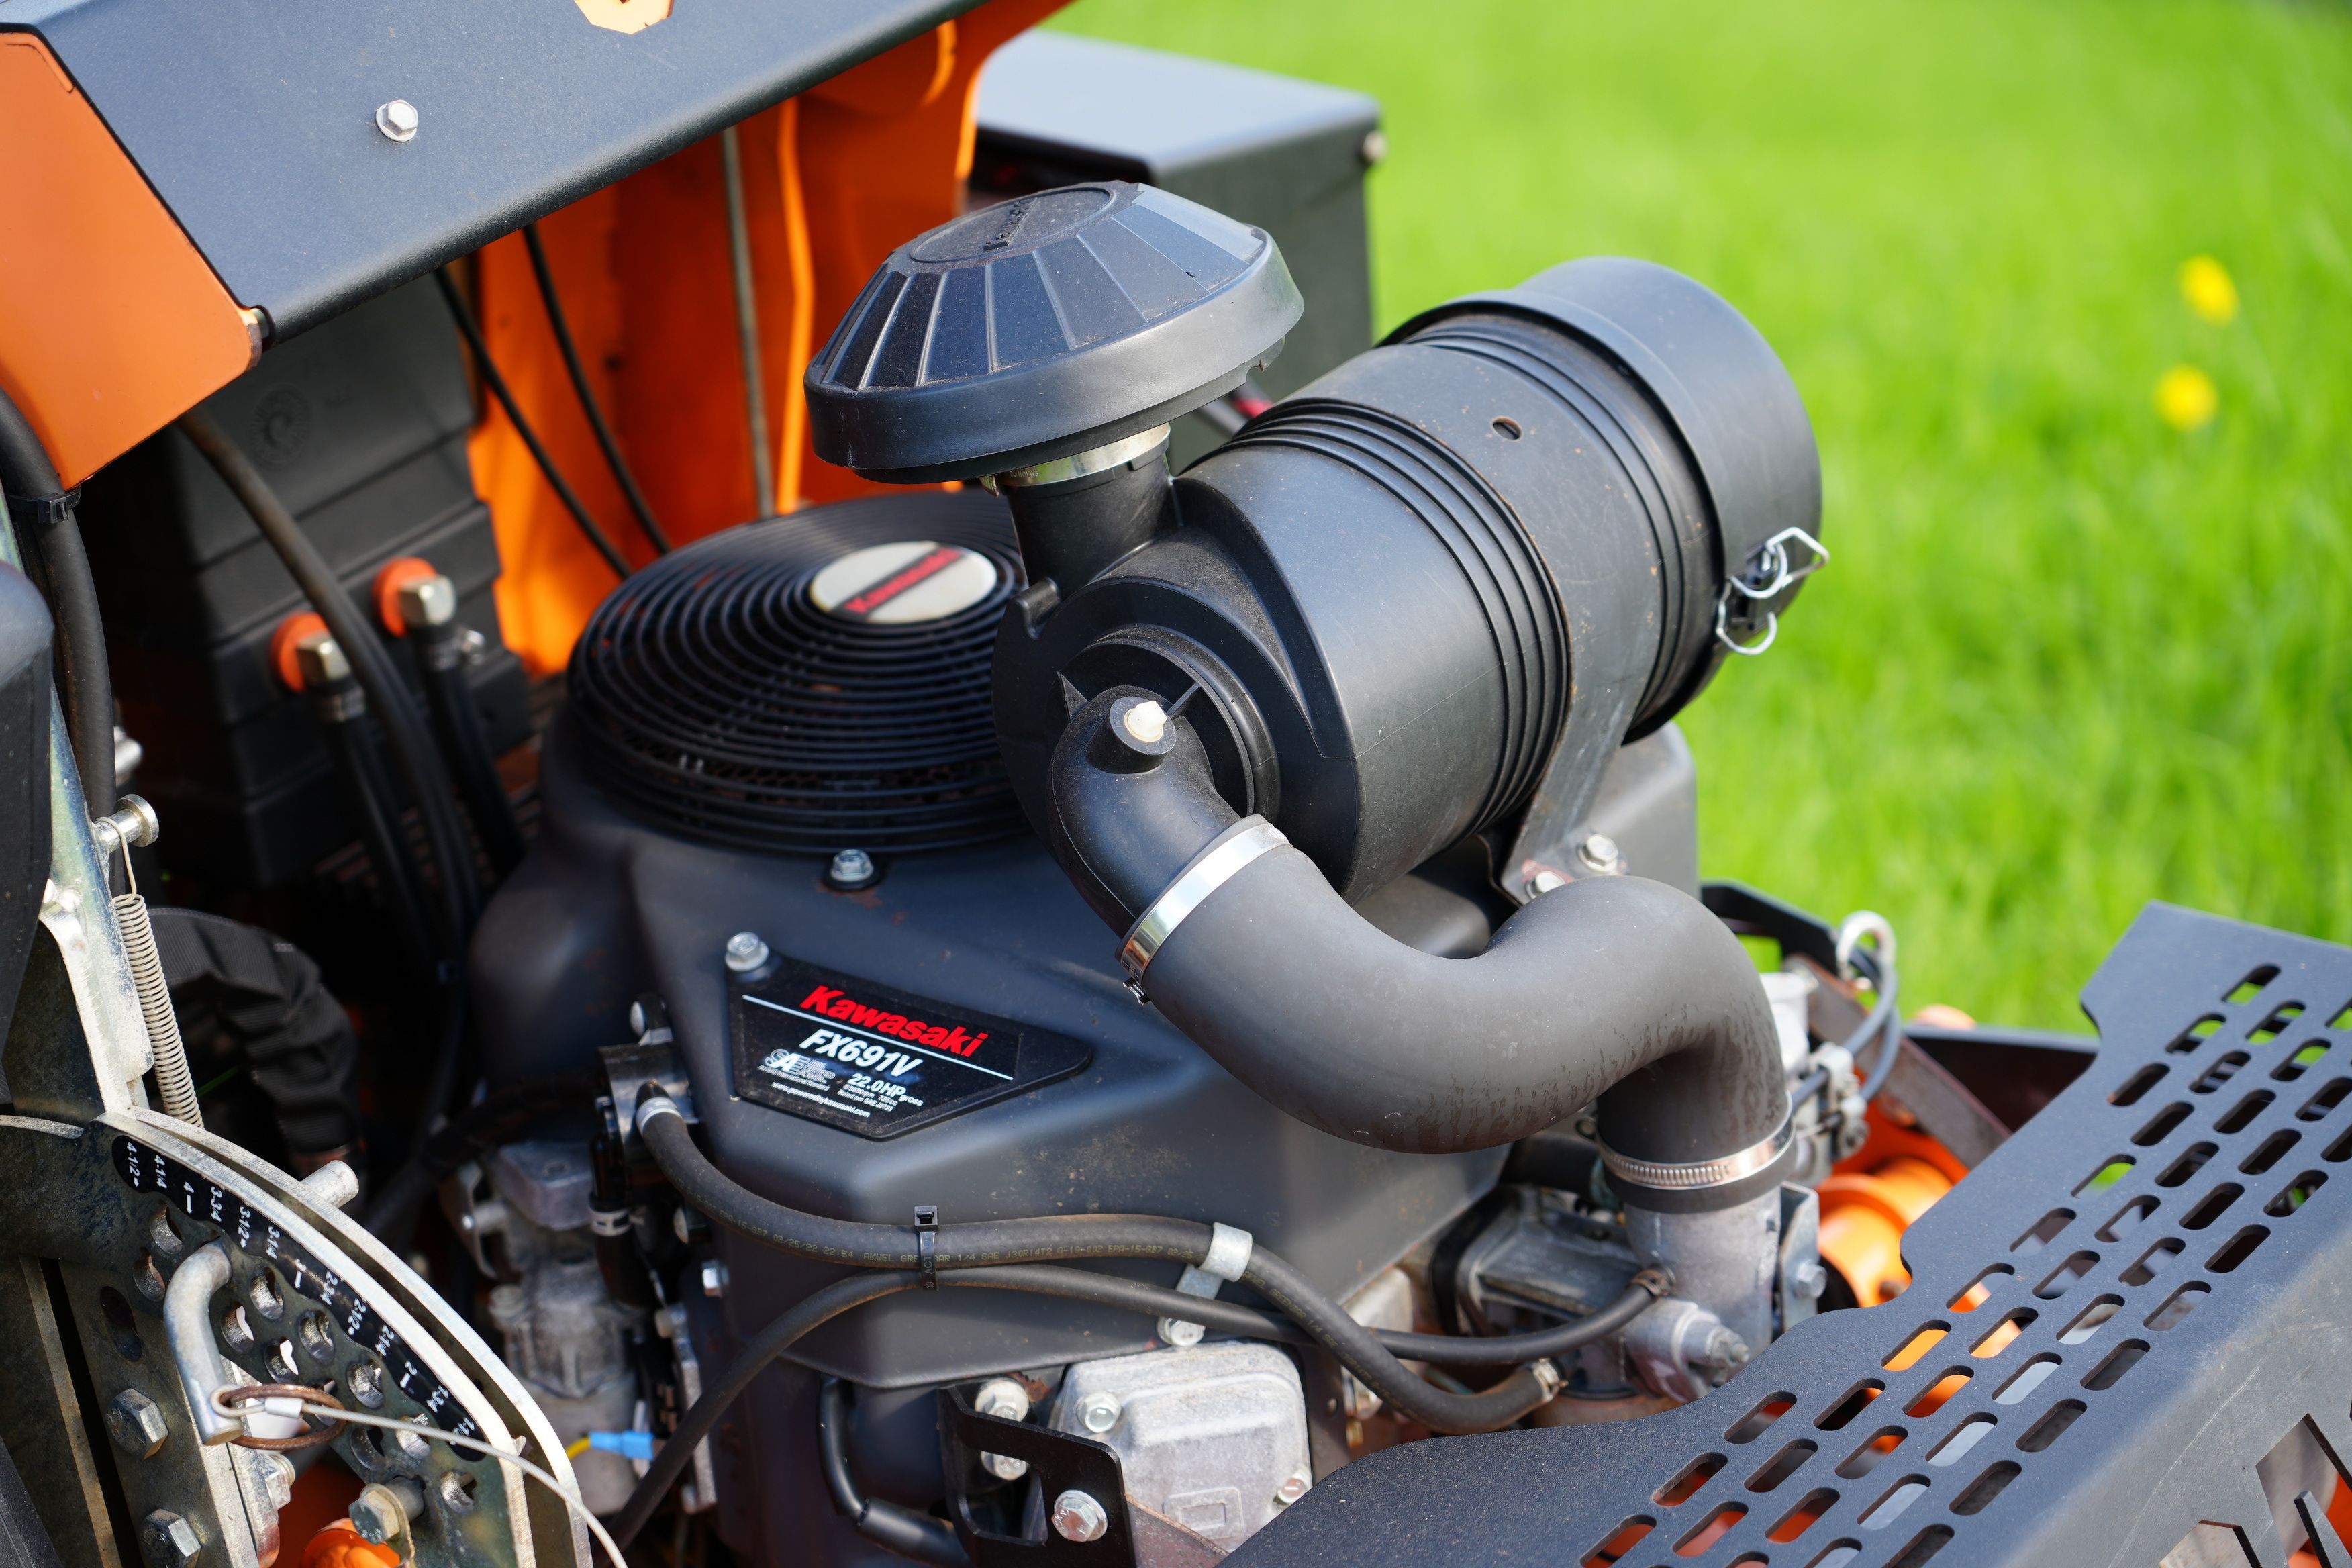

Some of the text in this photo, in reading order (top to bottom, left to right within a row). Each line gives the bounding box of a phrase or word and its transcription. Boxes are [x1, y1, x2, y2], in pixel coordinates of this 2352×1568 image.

[800, 985, 989, 1057] Kawasaki
[765, 1049, 811, 1075] SAE
[799, 1028, 924, 1077] FX691V
[771, 1081, 871, 1118] www.poweredbykawasaki.com
[837, 1089, 856, 1099] Rated
[863, 1097, 877, 1106] SAE
[847, 1073, 924, 1106] 22.0HP gross
[127, 1142, 140, 1176] 4-1/2
[154, 1154, 168, 1189] 4-1/4
[183, 1181, 195, 1193] 4
[210, 1186, 223, 1222] 3-3/4
[238, 1206, 251, 1239] 3-1/2
[265, 1226, 280, 1260] 3-1/4
[773, 1234, 818, 1253] 02/25/22
[823, 1246, 854, 1257] 22:54
[863, 1252, 894, 1262] AKWEL
[901, 1253, 951, 1263] GREBAR
[958, 1253, 976, 1261] 1/4
[981, 1251, 999, 1260] SAE
[294, 1258, 307, 1272] 3
[320, 1271, 338, 1306] 2-3/4
[348, 1297, 366, 1330] 2-1/2
[405, 1361, 418, 1376] 2
[426, 1385, 449, 1413] 1-3/4
